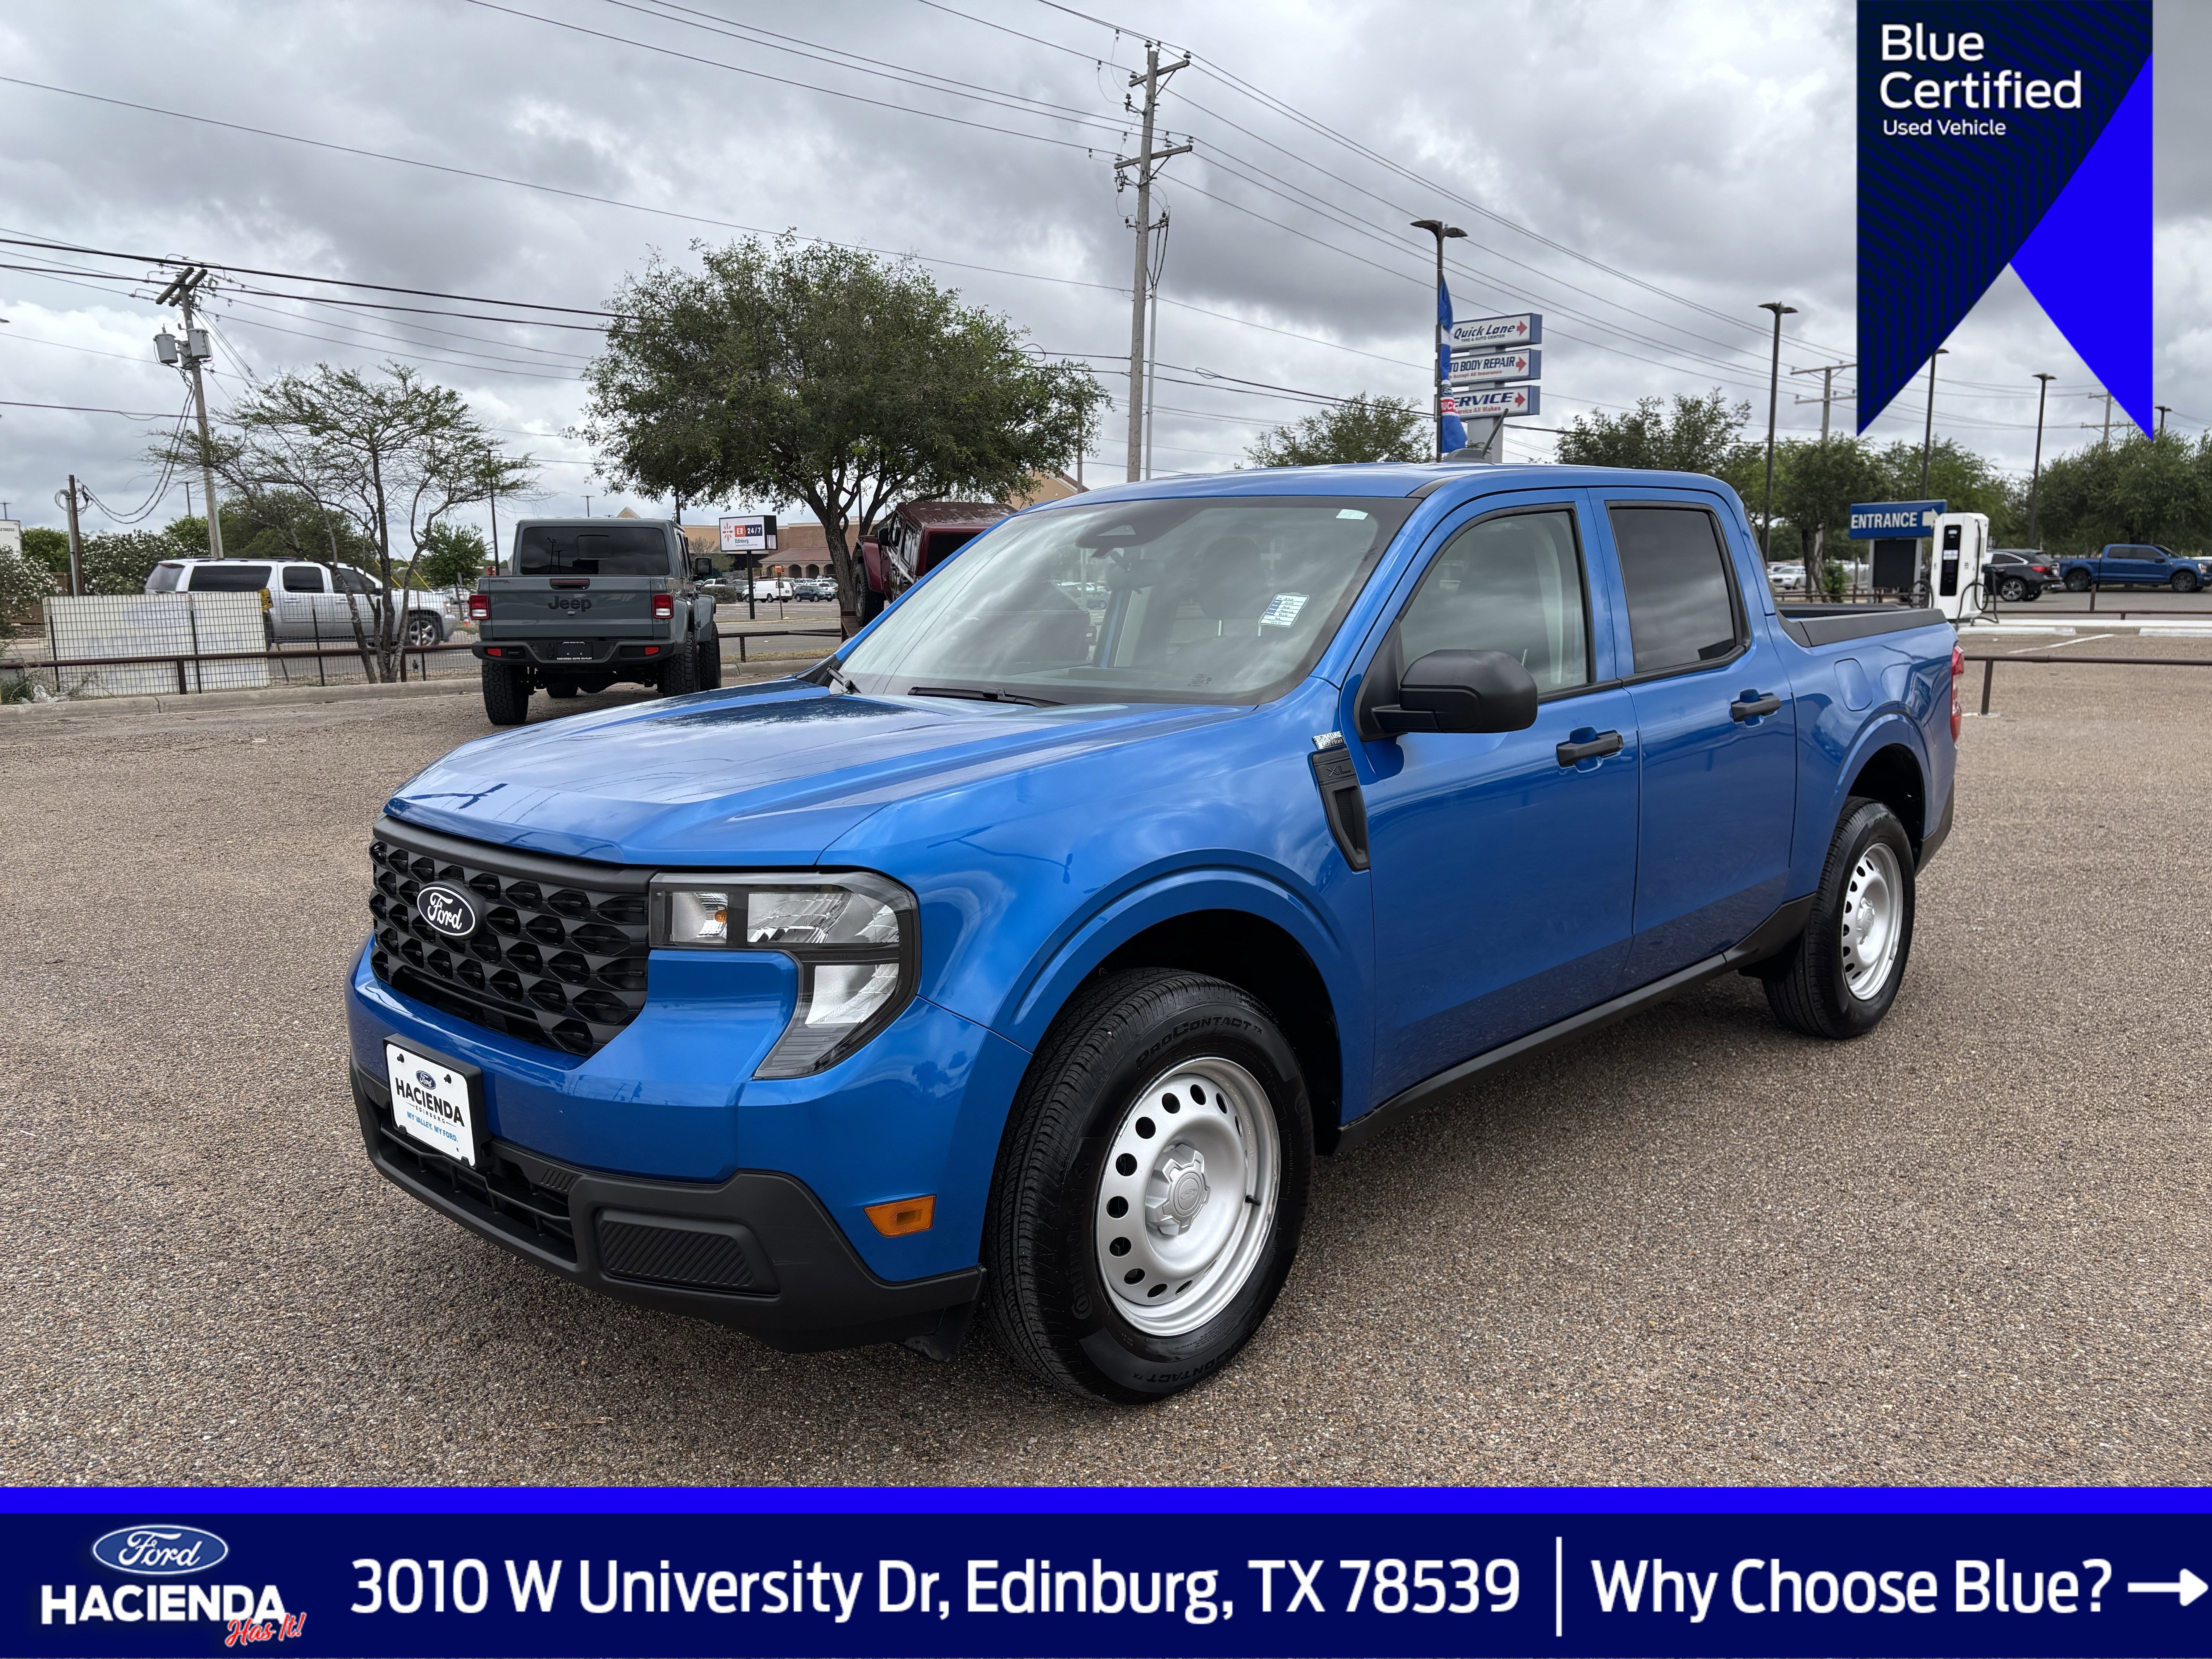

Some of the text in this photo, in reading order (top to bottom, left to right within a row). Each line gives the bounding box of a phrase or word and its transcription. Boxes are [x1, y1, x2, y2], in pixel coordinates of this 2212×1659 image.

[1454, 325, 1515, 339] Quick Lane
[1450, 356, 1515, 373] TO BODY REPAIR
[1455, 392, 1514, 407] ERVICE
[1851, 512, 1918, 529] ENTRANCE
[548, 596, 592, 612] Jeep
[1313, 731, 1341, 742] SIGNATURE
[1322, 738, 1343, 747] EDITION
[1326, 765, 1351, 777] XL
[427, 892, 462, 930] Ford
[1254, 1025, 1263, 1035] TX
[419, 1073, 432, 1088] Ford
[395, 1077, 465, 1127] HACIENDA
[416, 1105, 445, 1124] EDINBURG
[407, 1111, 459, 1143] MY VALLEY. MY FORD.
